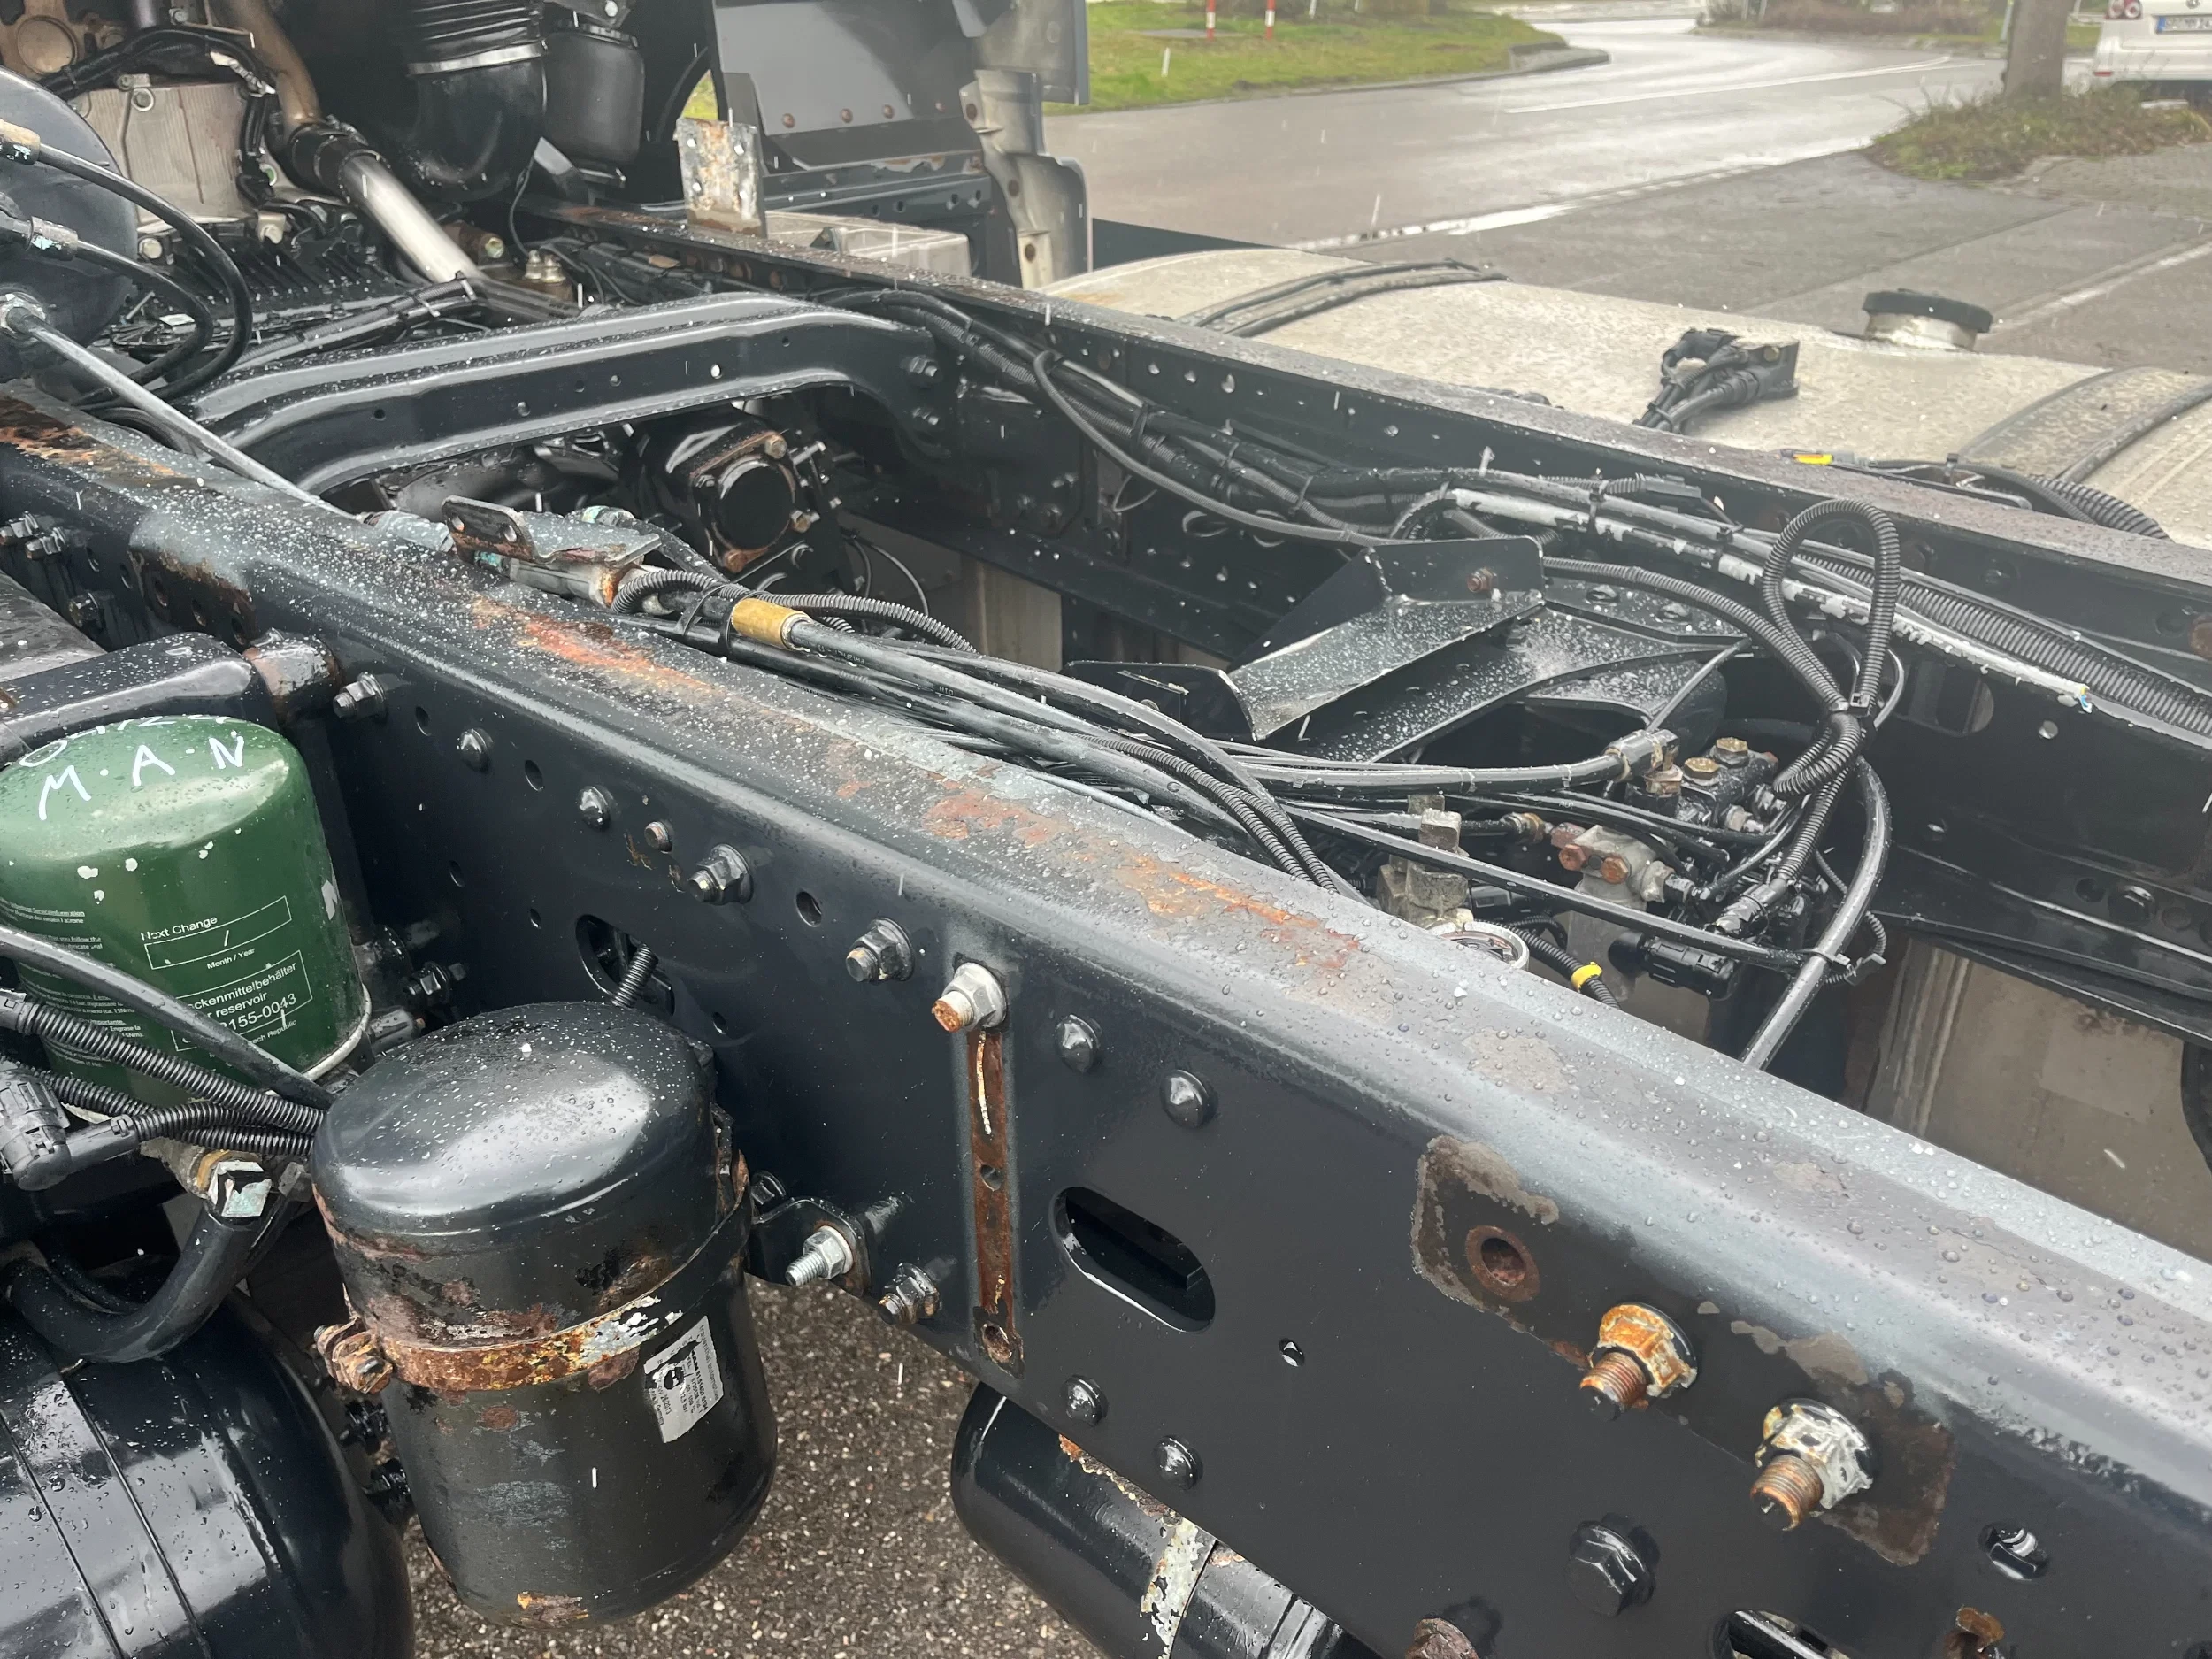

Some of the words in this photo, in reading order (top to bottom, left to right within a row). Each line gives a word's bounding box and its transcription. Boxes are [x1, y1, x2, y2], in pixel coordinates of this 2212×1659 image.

[172, 916, 219, 935] Change
[206, 956, 234, 970] Month
[237, 947, 256, 958] Year
